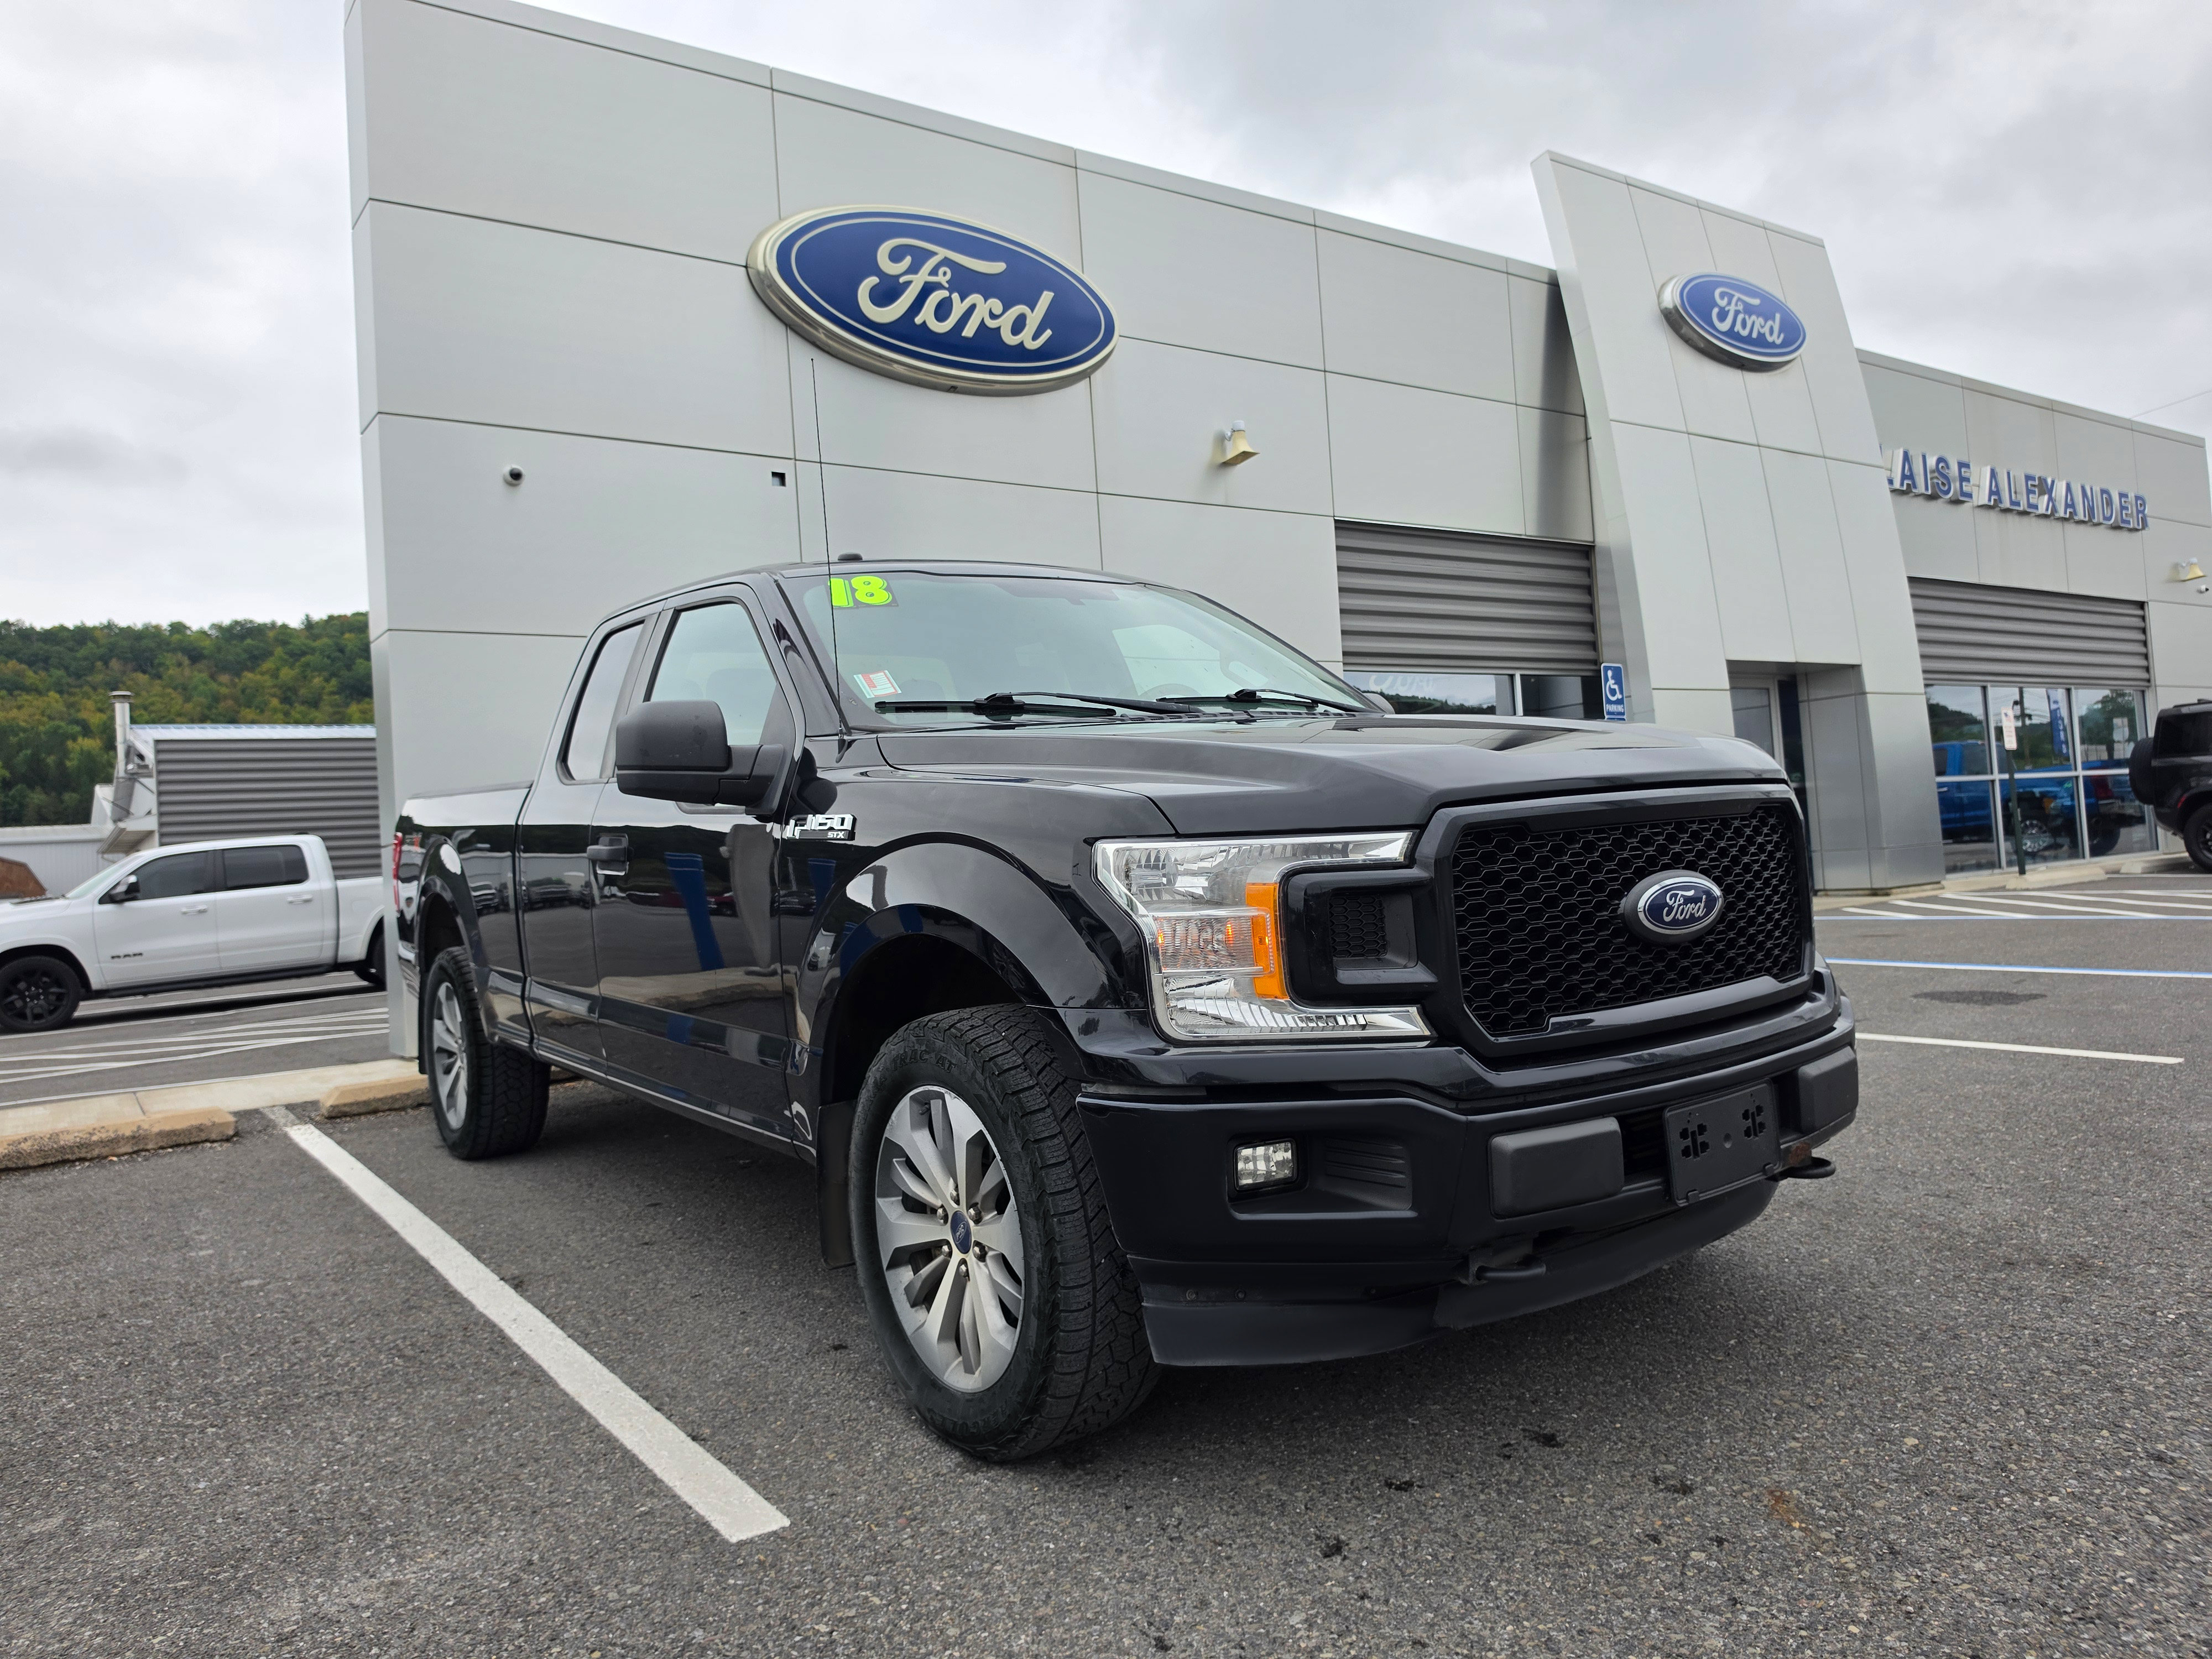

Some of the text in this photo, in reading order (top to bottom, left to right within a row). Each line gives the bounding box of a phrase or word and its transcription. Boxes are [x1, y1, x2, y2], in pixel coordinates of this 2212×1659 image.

[858, 238, 1054, 349] Ford
[1712, 287, 1785, 345] Ford
[1987, 465, 2149, 530] ALEXANDER
[828, 575, 893, 607] 18
[1606, 703, 1624, 712] PARKING
[1663, 889, 1707, 922] Ford
[891, 1048, 928, 1071] TRAC
